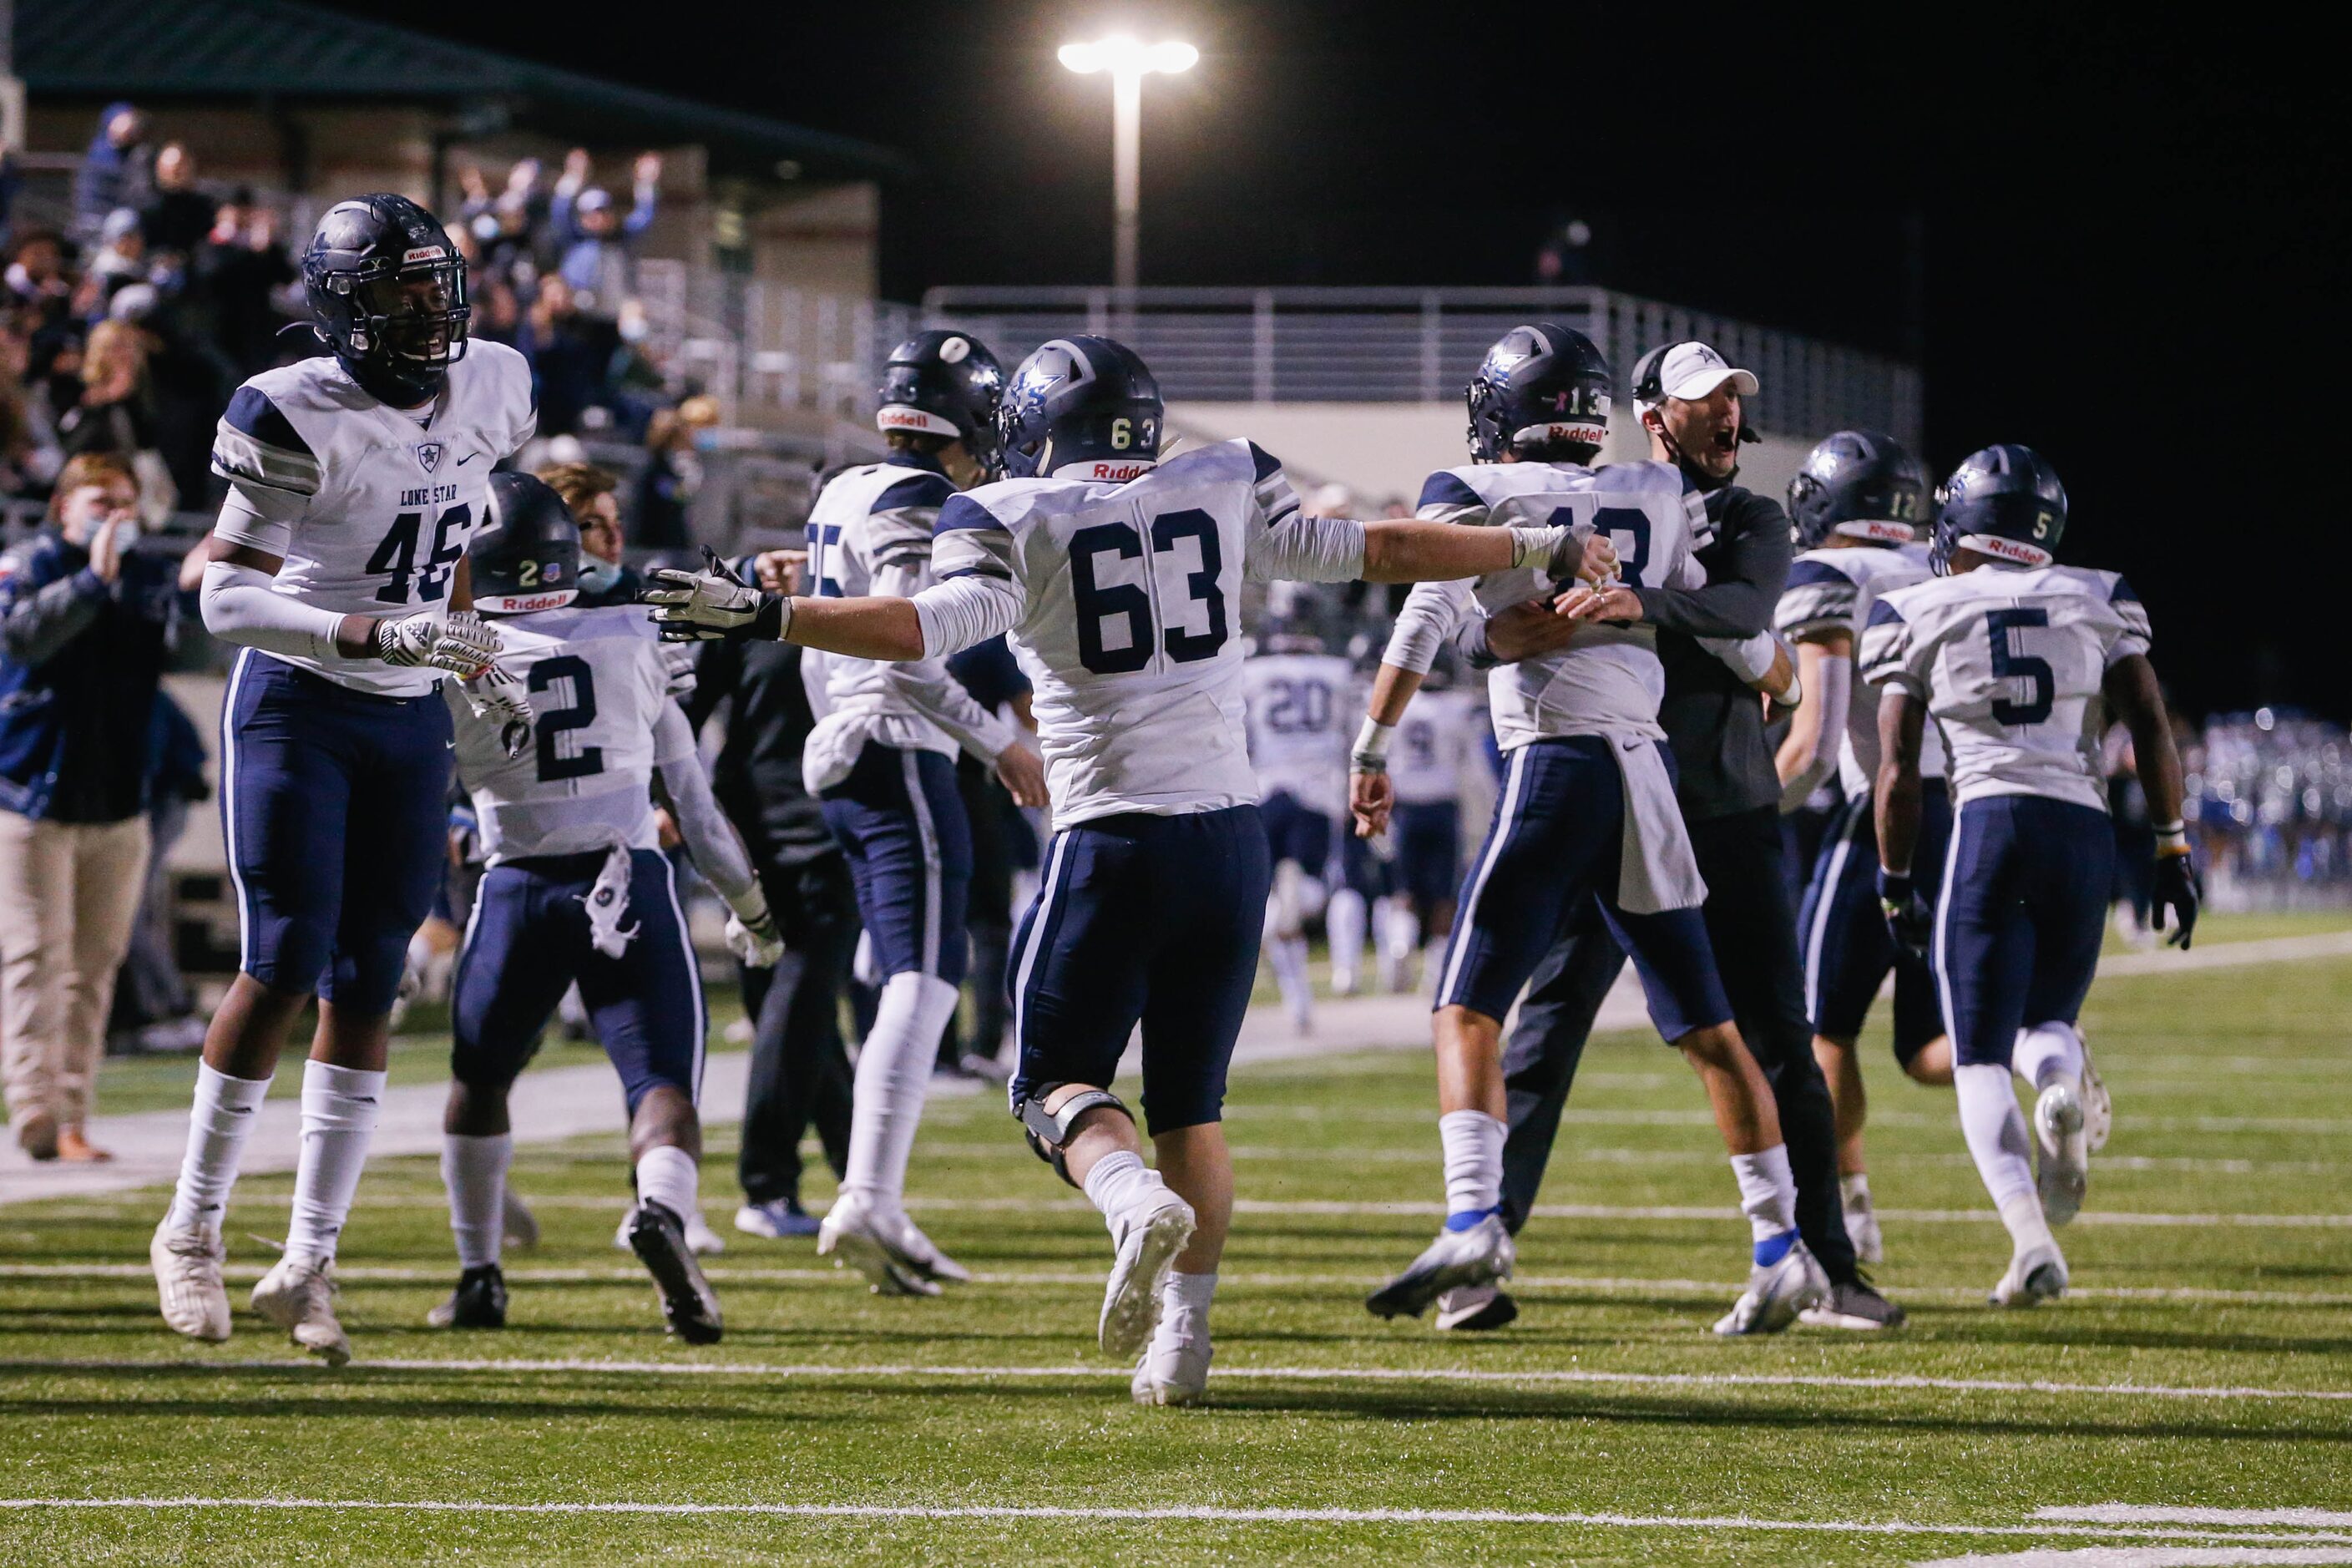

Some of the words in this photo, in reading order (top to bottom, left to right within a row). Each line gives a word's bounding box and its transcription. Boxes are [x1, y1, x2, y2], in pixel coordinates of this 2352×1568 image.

[1570, 387, 1601, 416] 13
[1111, 417, 1155, 450] 63
[1094, 463, 1159, 480] Ridd
[401, 490, 428, 506] LONE
[433, 484, 457, 503] STAR
[2032, 511, 2053, 539] 5
[366, 503, 472, 604] 46
[518, 559, 539, 586] 2
[503, 594, 567, 610] Riddell
[1068, 508, 1228, 675] 63
[1985, 608, 2055, 726] 5
[529, 655, 604, 781] 2
[1265, 680, 1332, 733] 20
